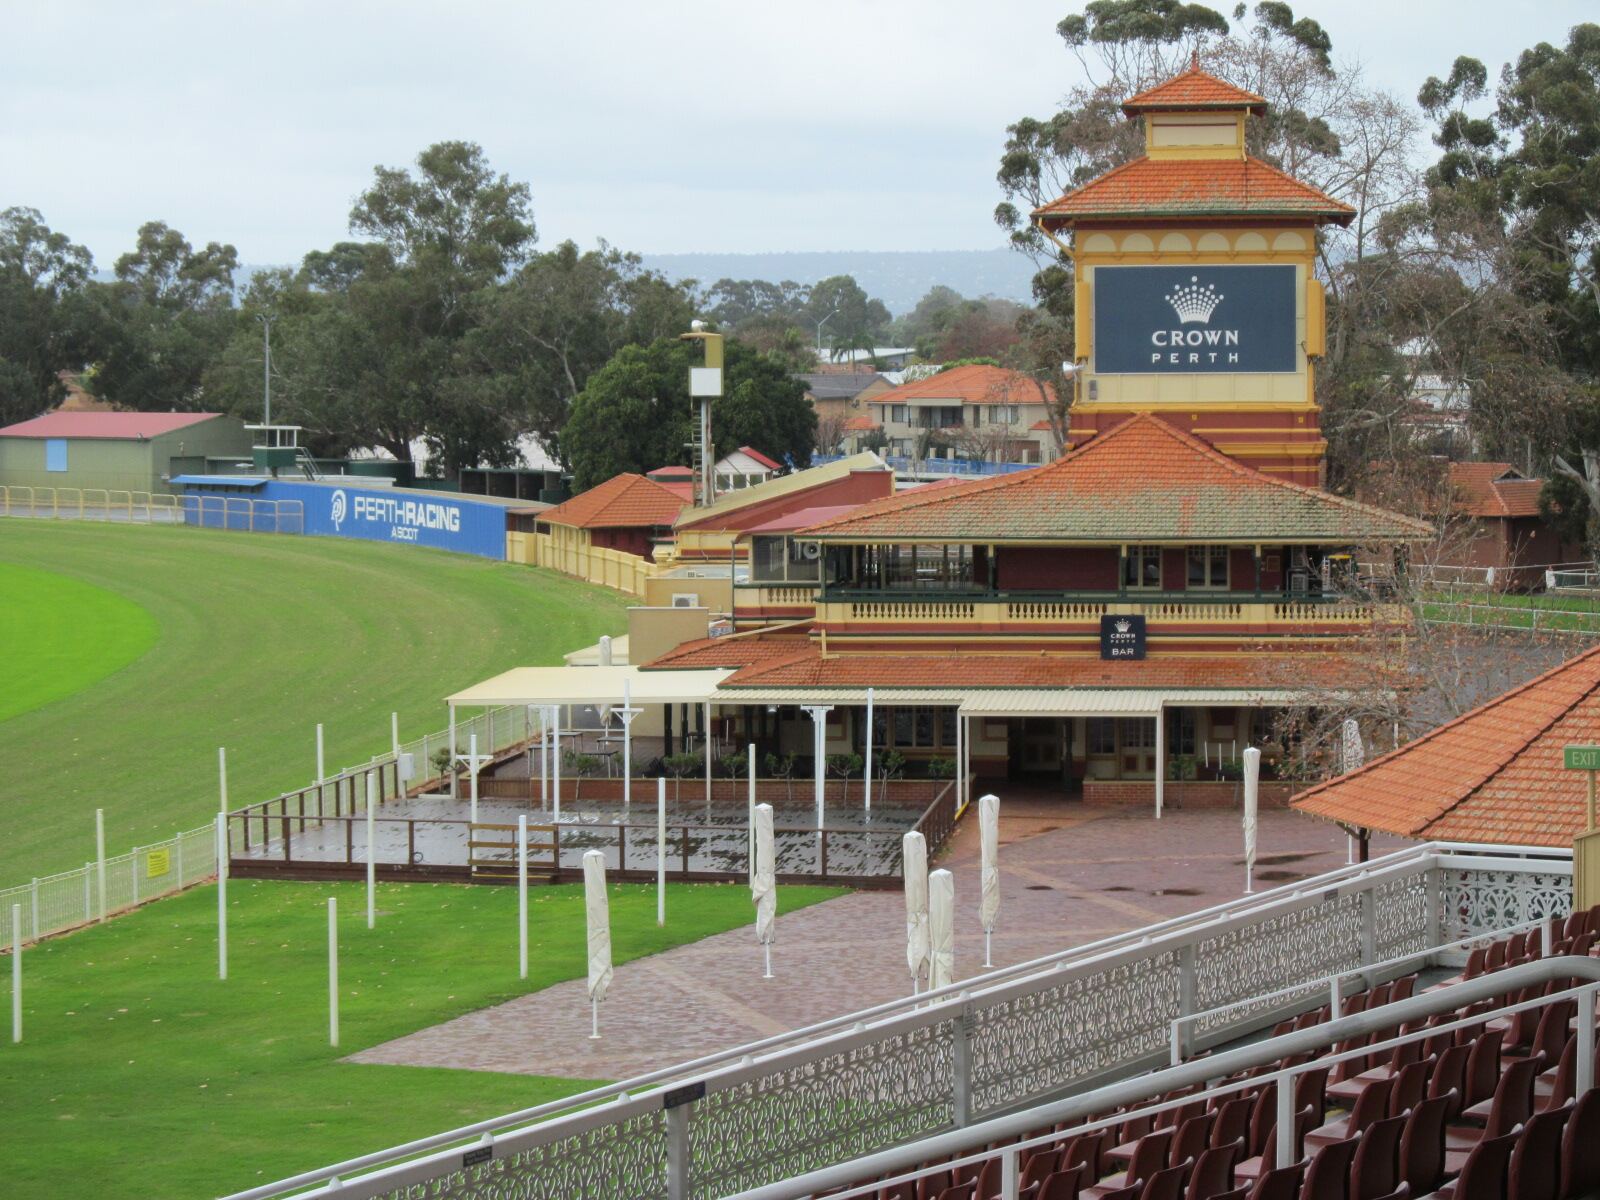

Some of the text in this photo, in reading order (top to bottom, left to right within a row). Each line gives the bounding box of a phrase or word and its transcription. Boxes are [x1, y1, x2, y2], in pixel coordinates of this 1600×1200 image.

[1151, 330, 1239, 346] CROWN
[1152, 353, 1239, 364] PERTH
[391, 526, 419, 541] ASCOT
[1112, 648, 1134, 656] BAR
[1572, 751, 1598, 766] EXIT
